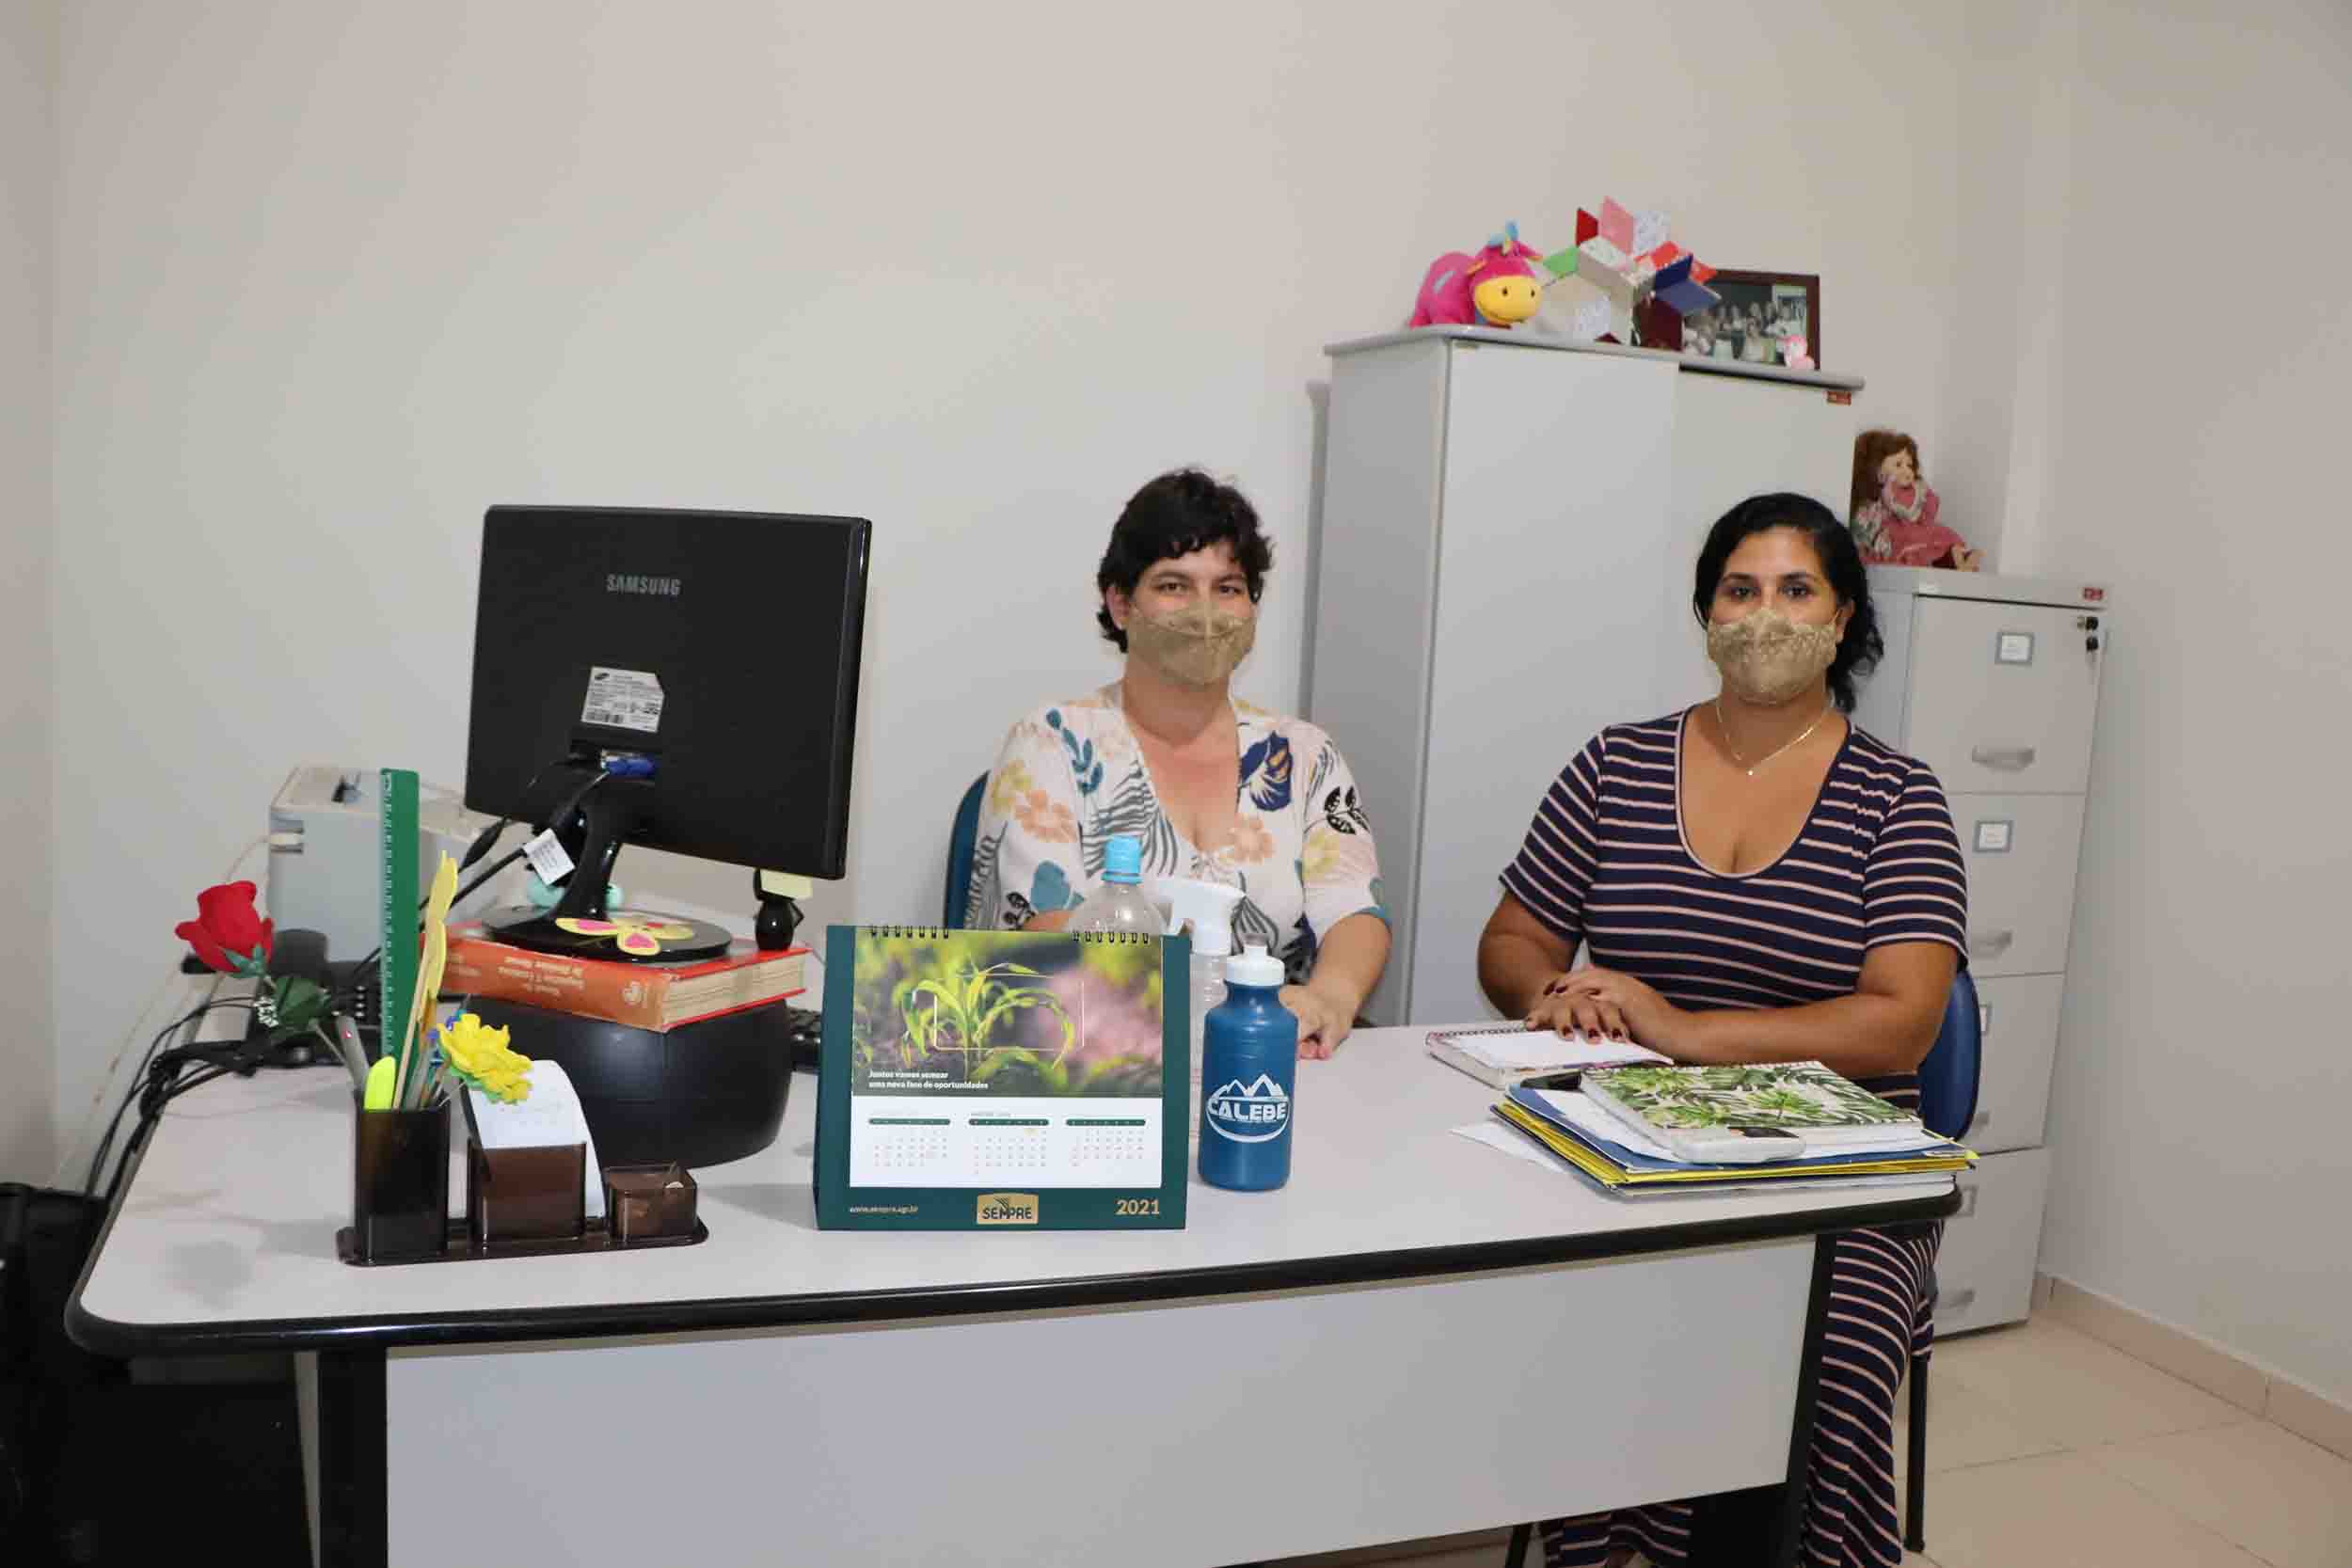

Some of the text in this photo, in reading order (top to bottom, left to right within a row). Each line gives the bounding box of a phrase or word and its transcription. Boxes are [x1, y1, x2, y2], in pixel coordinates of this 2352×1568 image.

[606, 574, 681, 595] SAMSUNG
[923, 1080, 933, 1088] de
[934, 1080, 989, 1090] oportunidades
[1207, 1098, 1287, 1122] CALEBE
[982, 1207, 1033, 1220] SEMPRE
[1115, 1198, 1160, 1215] 2021
